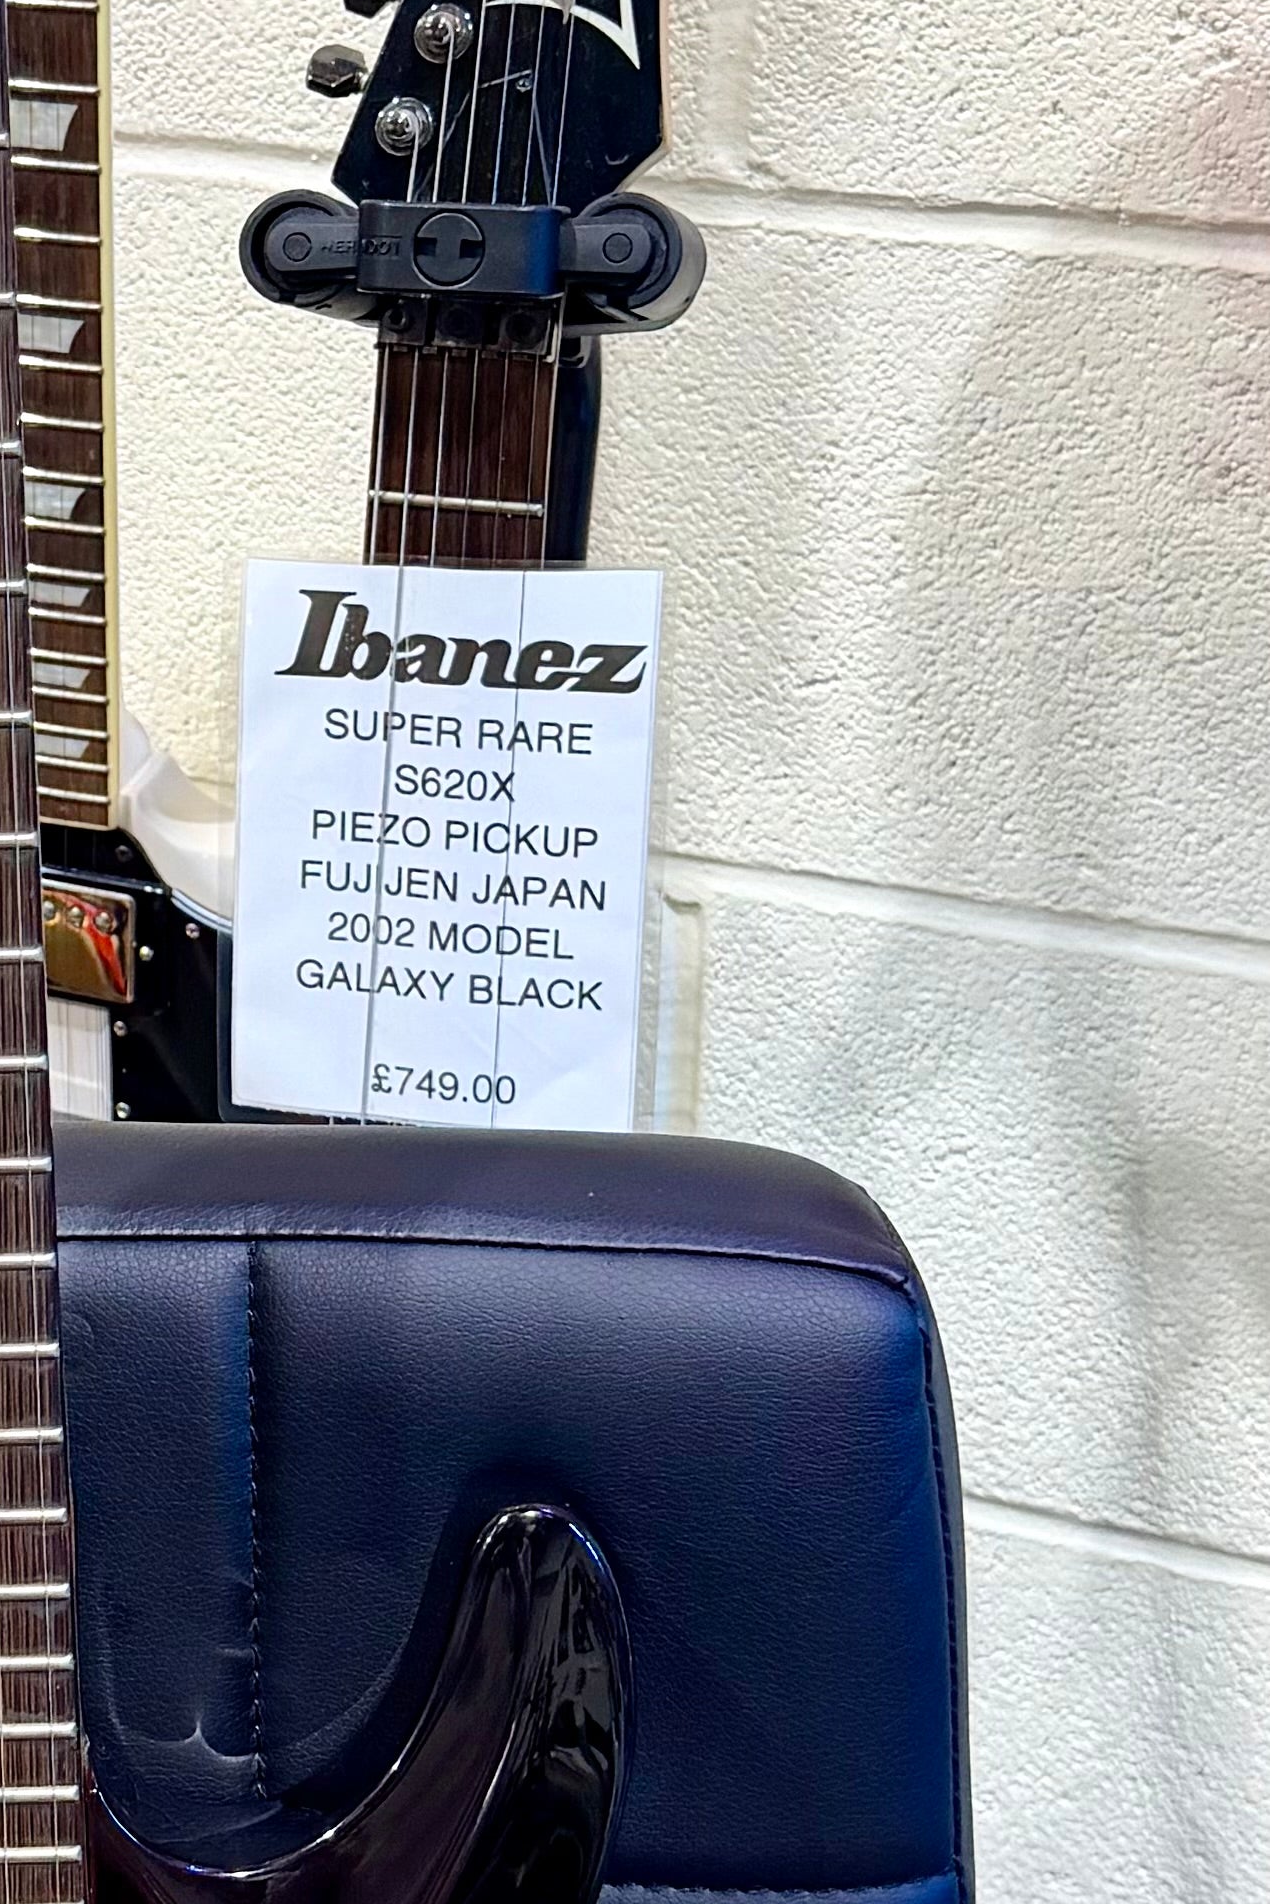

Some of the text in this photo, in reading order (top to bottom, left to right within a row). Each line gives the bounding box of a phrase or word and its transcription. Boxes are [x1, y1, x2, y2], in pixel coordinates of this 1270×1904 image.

[274, 589, 649, 694] Ibanez
[324, 708, 594, 755] SUPER RARE
[394, 764, 515, 803] S620X
[312, 809, 599, 859] PIEZO PICKUP
[472, 873, 606, 911] JAPAN
[327, 911, 574, 960] 2002 MODEL
[296, 959, 603, 1011] GALAXY BLACK
[371, 1063, 516, 1105] £749.00
